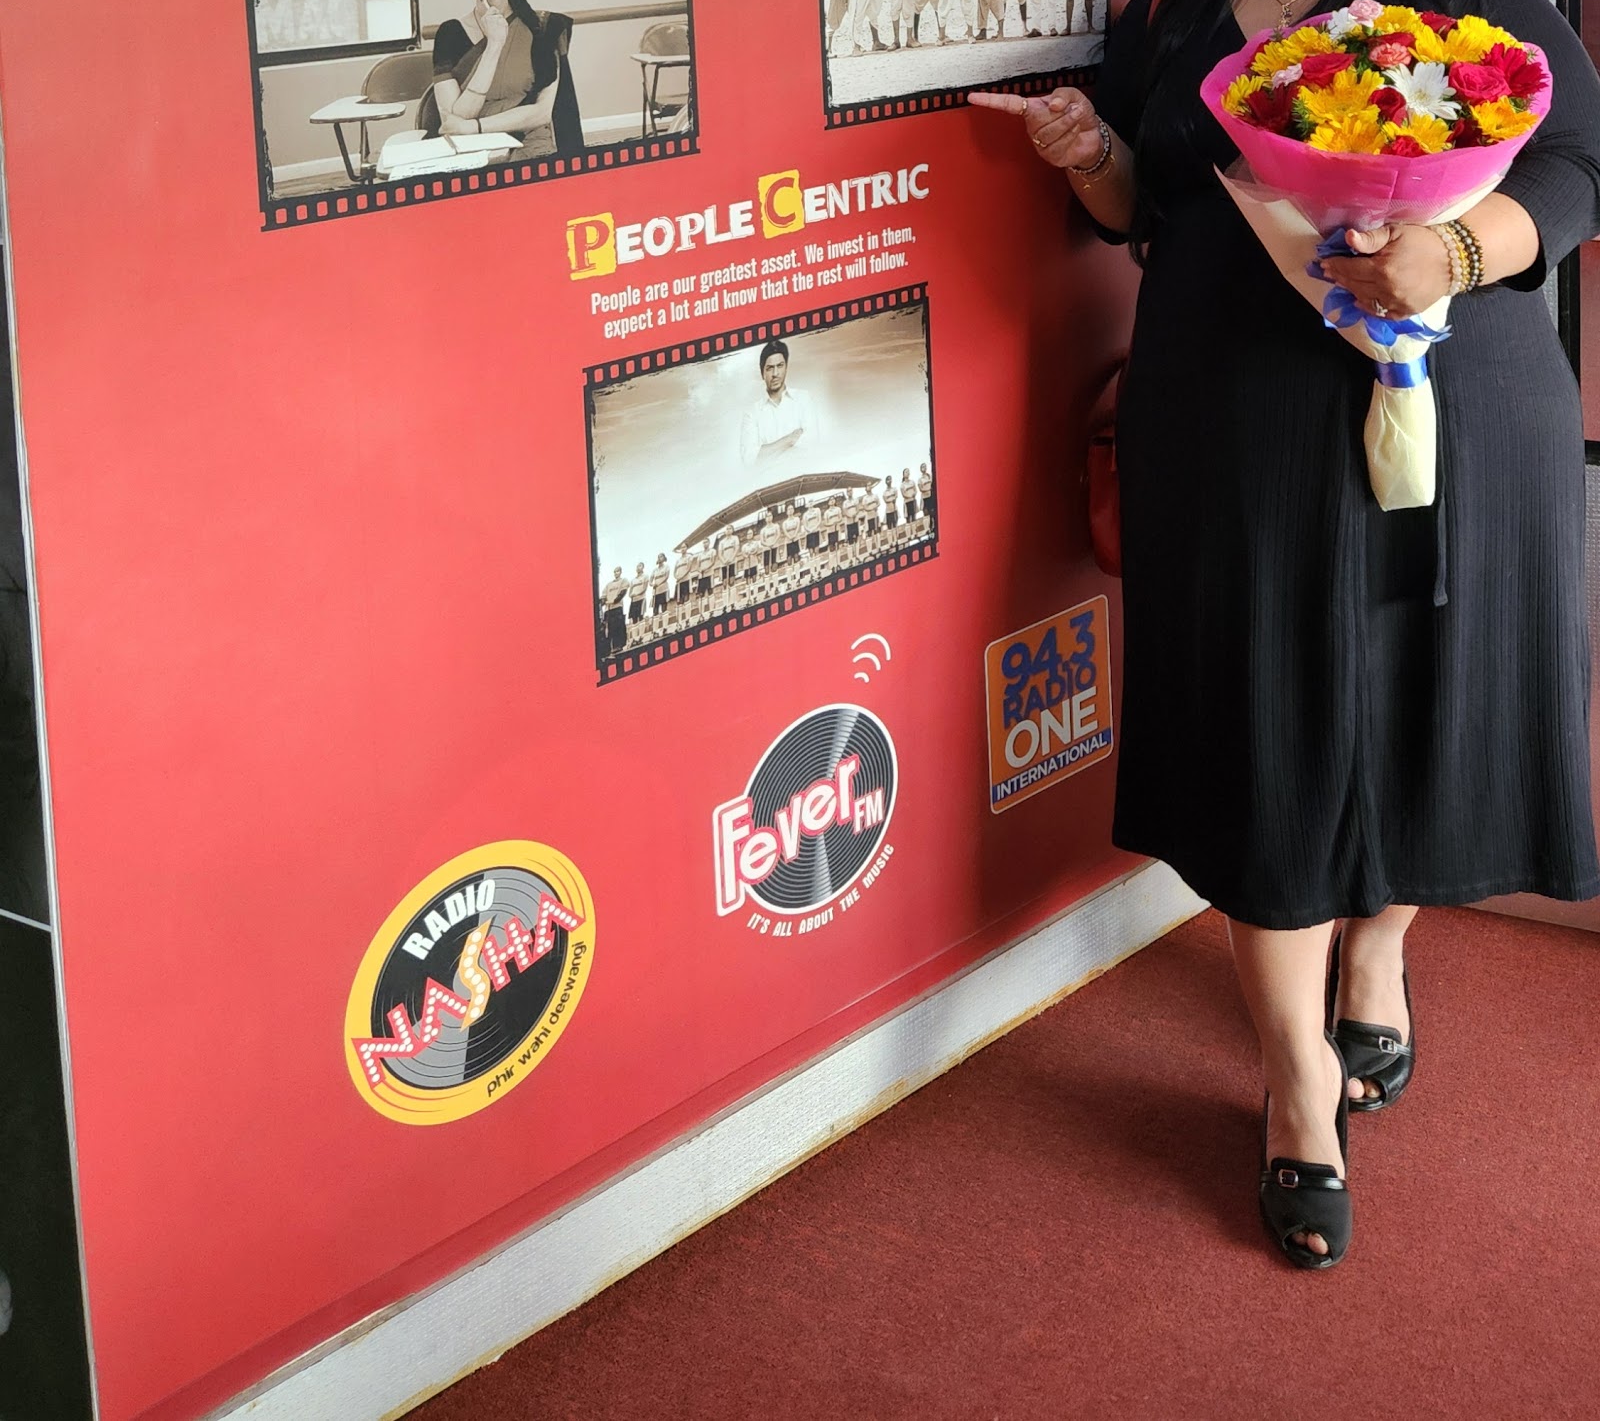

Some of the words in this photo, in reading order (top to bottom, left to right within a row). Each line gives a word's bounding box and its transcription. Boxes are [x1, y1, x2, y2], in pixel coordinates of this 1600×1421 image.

[567, 201, 755, 280] PEOPLE
[757, 164, 930, 239] CENTRIC
[591, 286, 641, 315] People
[645, 281, 669, 303] are
[673, 272, 697, 293] our
[700, 258, 757, 292] greatest
[761, 253, 801, 275] asset.
[804, 243, 825, 265] We
[827, 234, 864, 258] invest
[866, 233, 879, 252] in
[882, 225, 916, 247] them,
[604, 311, 653, 340] expect
[657, 310, 666, 326] a
[670, 299, 690, 320] lot
[694, 295, 717, 317] and
[722, 286, 757, 311] know
[760, 277, 789, 301] that
[792, 271, 813, 294] the
[816, 265, 843, 286] rest
[845, 257, 867, 279] will
[869, 251, 909, 275] follow.
[1003, 661, 1097, 729] RADIO
[1004, 685, 1098, 769] ONE
[996, 732, 1108, 801] INTERNATIONAL
[713, 753, 860, 909] Fever
[853, 787, 884, 835] FM
[402, 879, 496, 960] RADIO
[747, 912, 771, 934] IT'S
[772, 921, 792, 937] ALL
[798, 907, 834, 934] ABOUT
[839, 887, 860, 912] THE
[862, 843, 895, 888] MUSIC
[351, 892, 586, 1090] NASHA
[486, 1064, 515, 1097] phir
[518, 1026, 551, 1066] wahi
[549, 941, 587, 1025] deewangi
